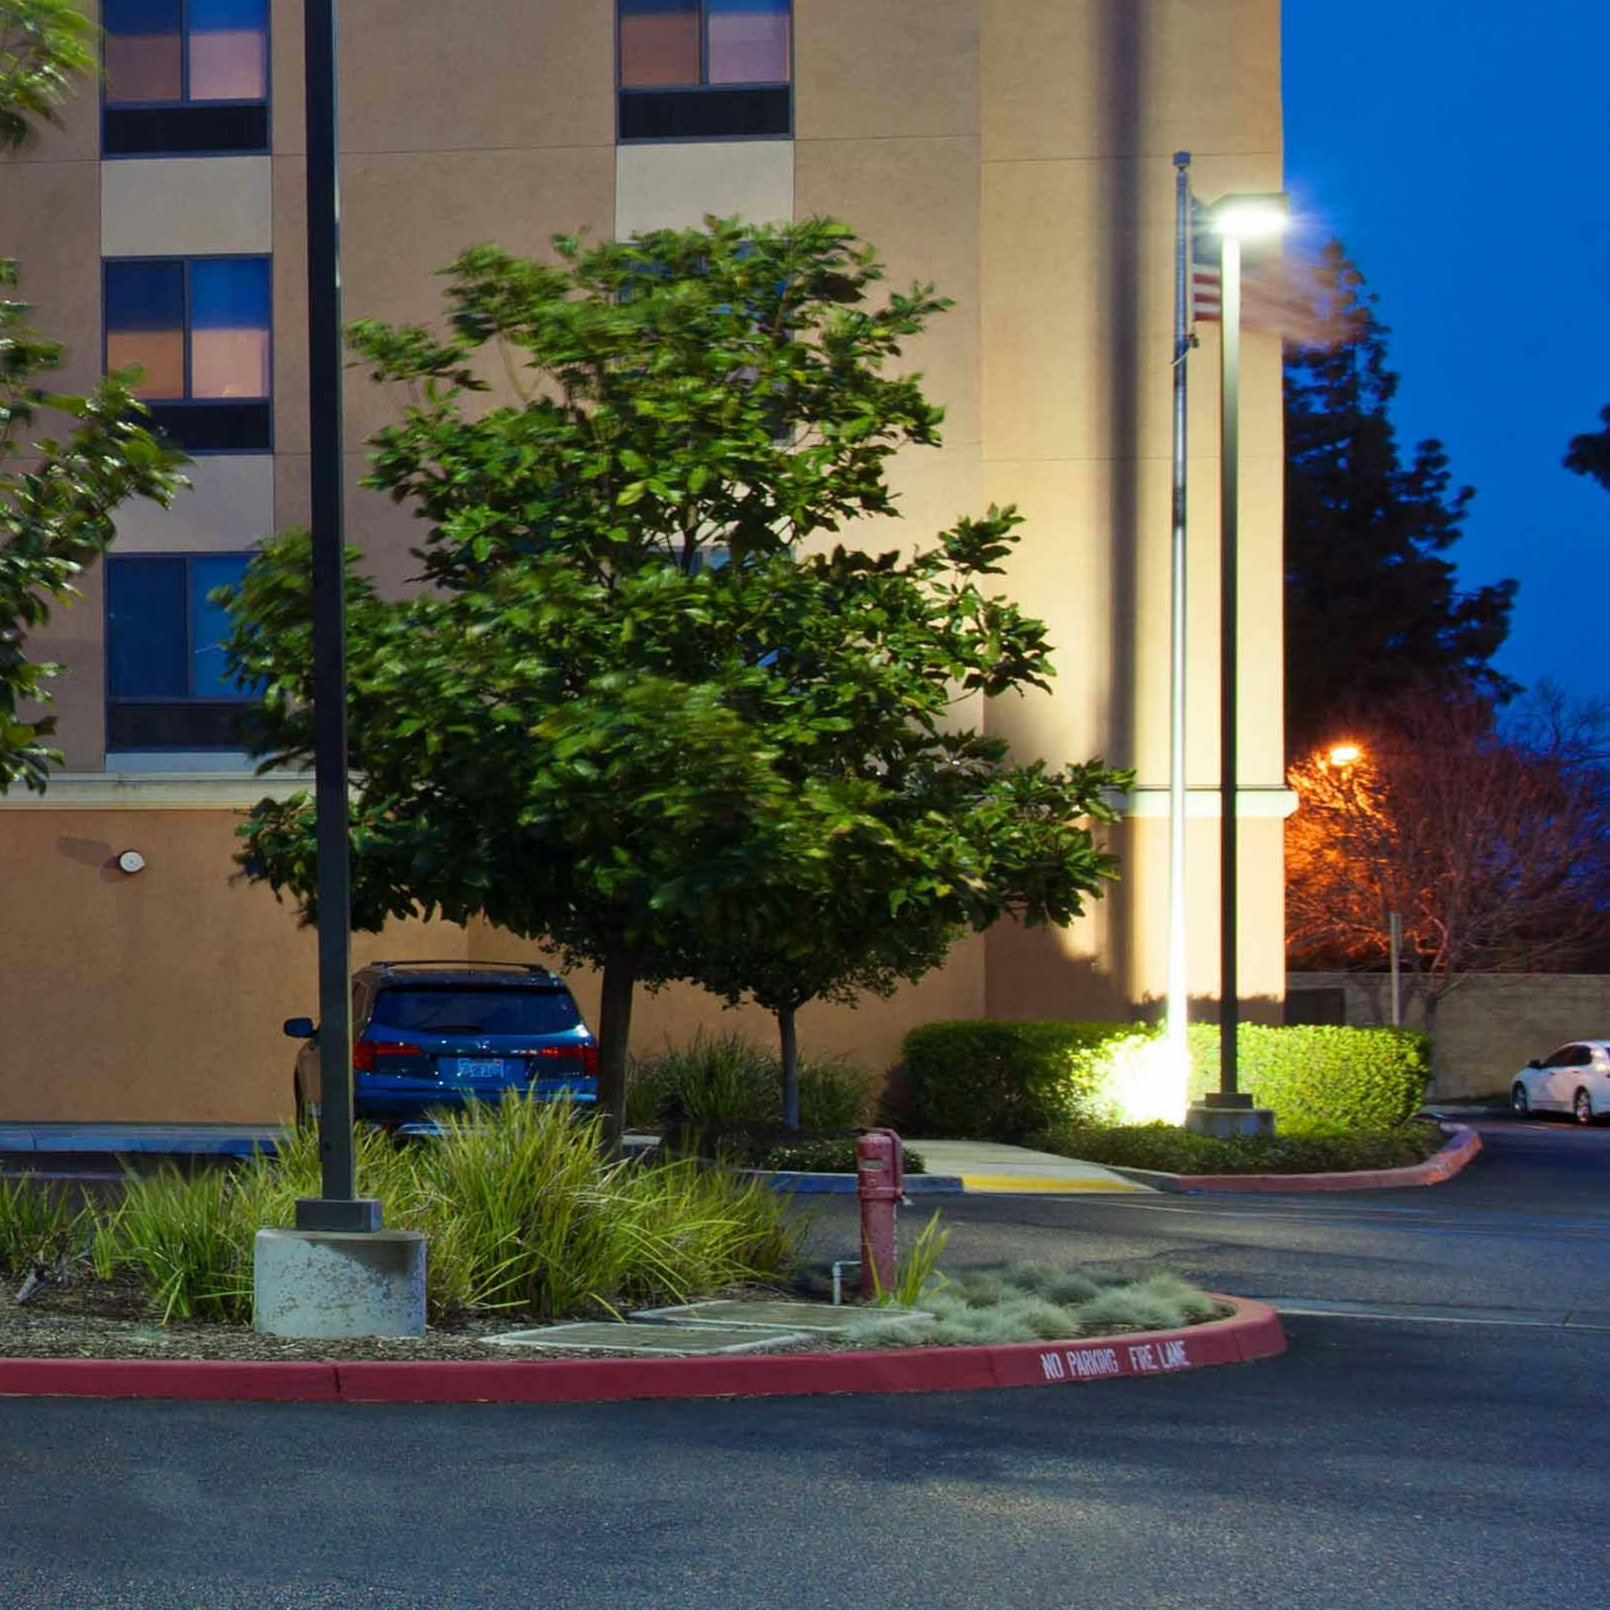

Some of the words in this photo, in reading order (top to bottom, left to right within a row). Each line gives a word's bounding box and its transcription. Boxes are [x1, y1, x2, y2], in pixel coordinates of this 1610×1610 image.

[1040, 1352, 1065, 1380] NO
[1066, 1348, 1119, 1377] PARKING
[1156, 1340, 1192, 1368] LANE
